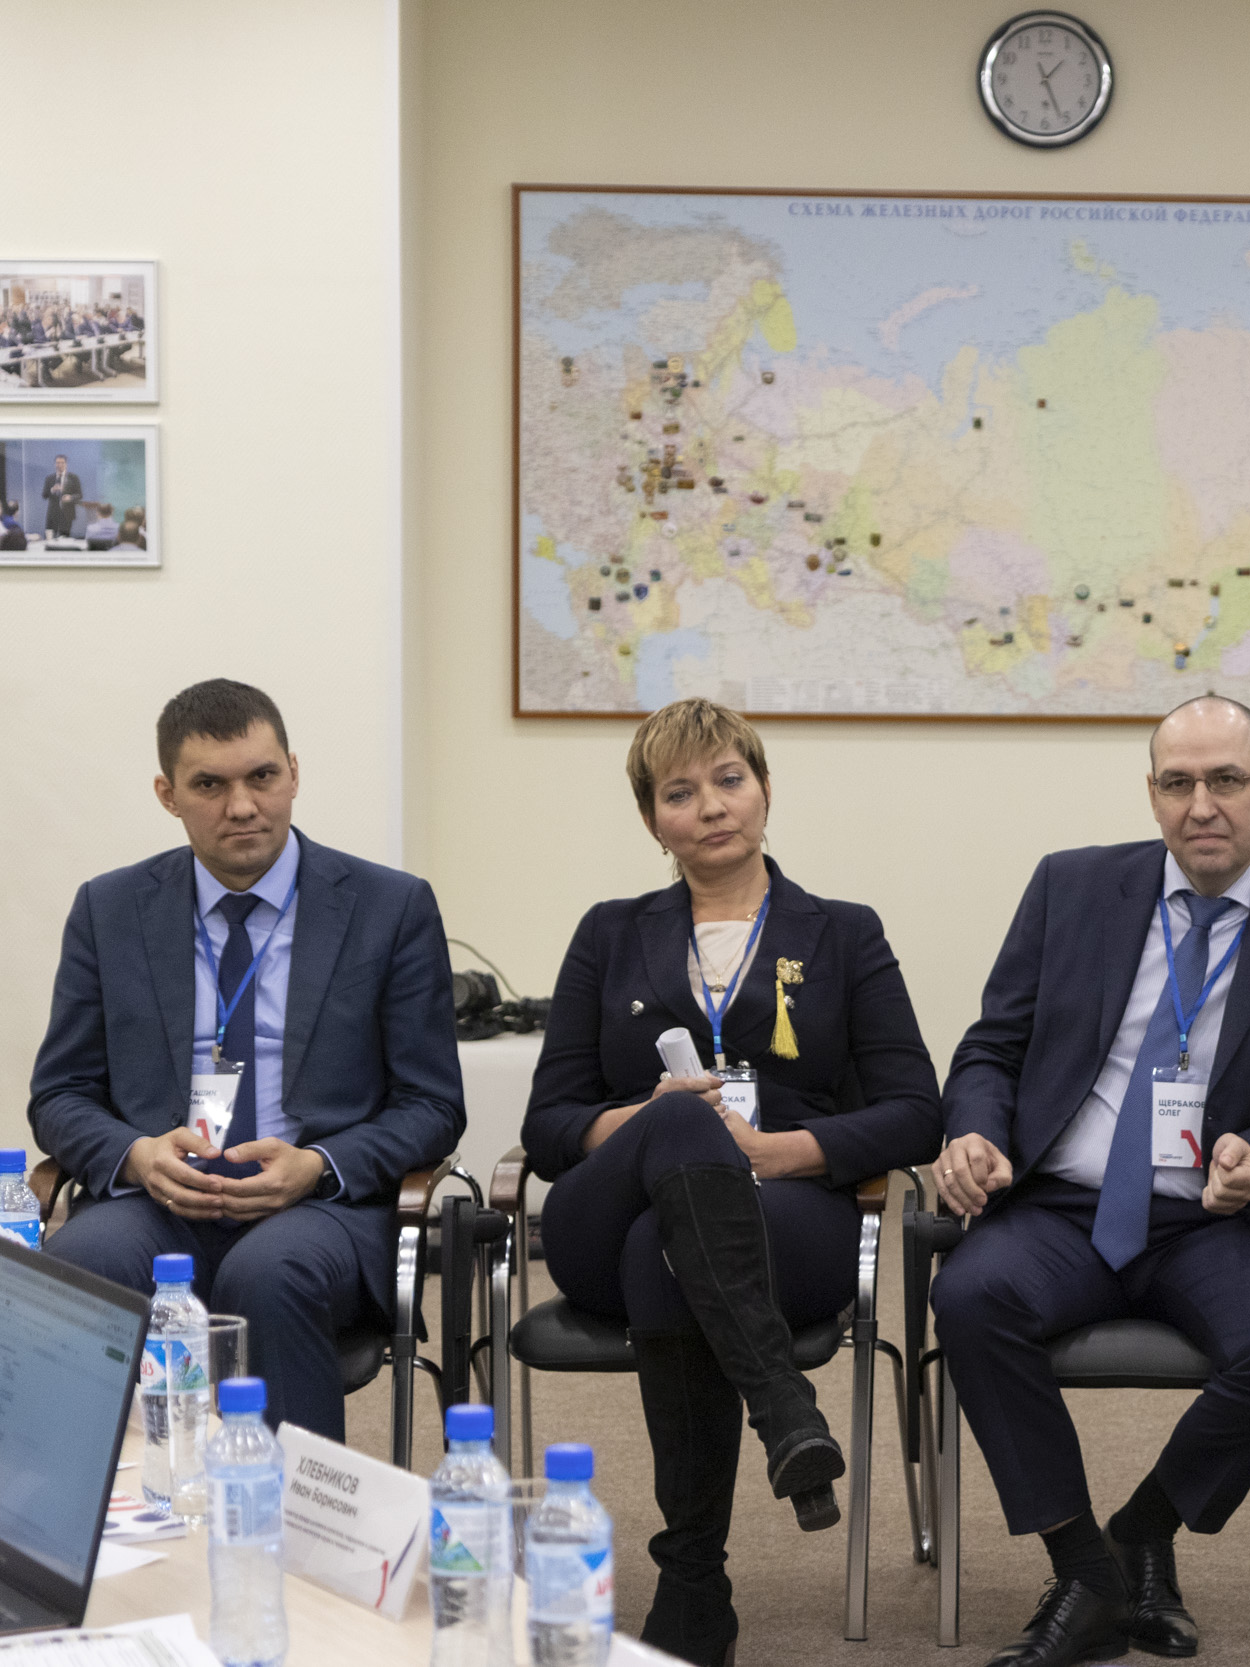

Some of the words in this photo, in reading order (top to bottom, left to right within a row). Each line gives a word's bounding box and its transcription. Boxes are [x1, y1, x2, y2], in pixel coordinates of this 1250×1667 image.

[787, 202, 854, 217] СХЕМА
[860, 203, 968, 219] ЖЕЛЕЗНЫХ
[973, 205, 1034, 221] ДОРОГ
[1040, 205, 1169, 222] РОССИЙСКОЙ
[295, 1455, 360, 1495] ХЛЕБНИКОВ
[290, 1478, 312, 1500] Иван
[311, 1486, 359, 1519] Борисович
